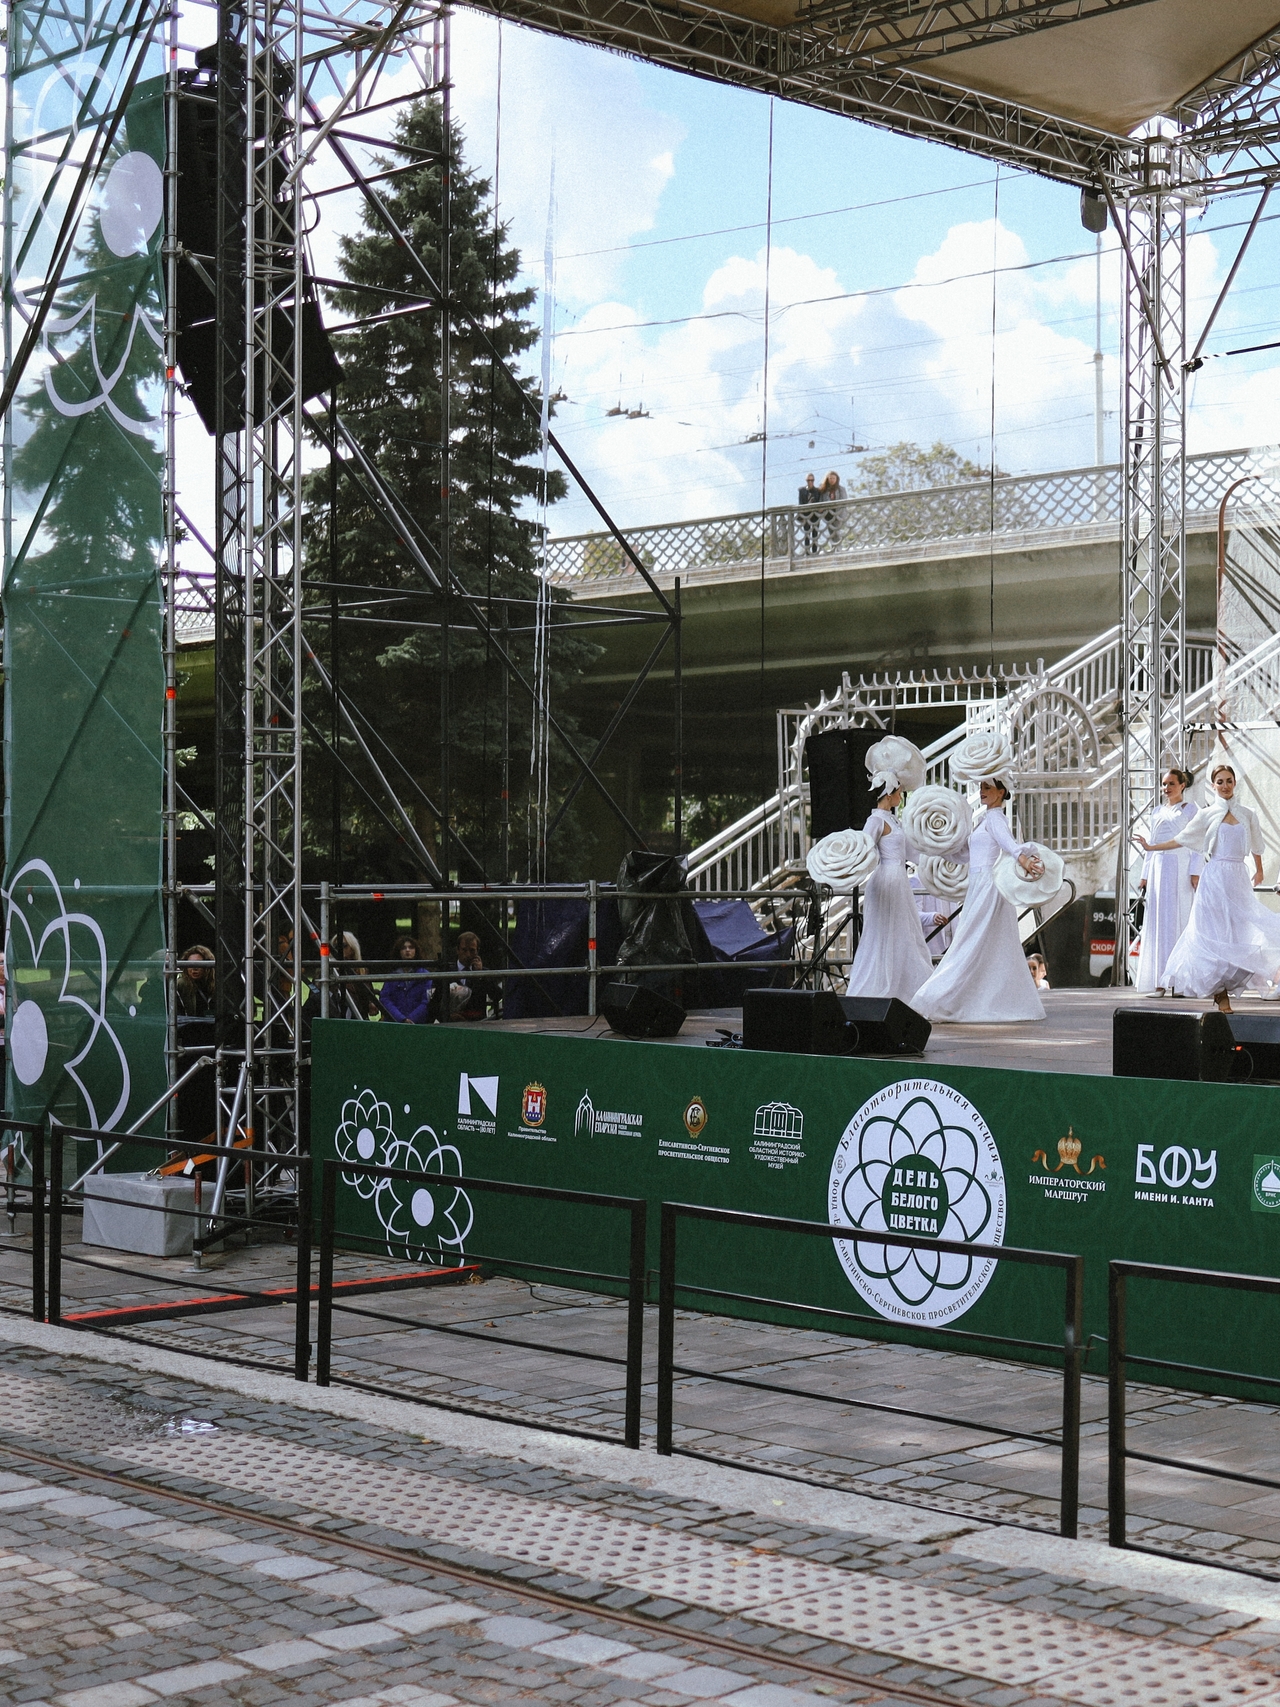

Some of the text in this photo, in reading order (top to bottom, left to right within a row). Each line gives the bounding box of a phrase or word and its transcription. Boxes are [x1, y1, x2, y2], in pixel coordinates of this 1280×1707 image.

[457, 1118, 496, 1127] КАЛИНИНГРАДСКАЯ
[840, 1081, 1000, 1163] Благотворительная акция
[748, 1146, 779, 1155] ОБЛАСТНОЙ
[753, 1140, 801, 1150] КАЛИНИНГРАДСКИЙ
[753, 1154, 799, 1164] ХУДОЖЕСТВЕННЫЙ
[767, 1162, 784, 1170] МУЗЕЙ
[1135, 1144, 1217, 1189] БФУ
[892, 1168, 939, 1189] ДЕНЬ
[1028, 1175, 1106, 1192] ИМПЕРАТОРСКИЙ
[891, 1191, 939, 1211] БЕЛОГО
[1044, 1189, 1088, 1203] МАРШРУТ
[1134, 1190, 1214, 1207] ИМЕНИ И. КАНТА
[889, 1213, 938, 1233] ЦВЕТКА
